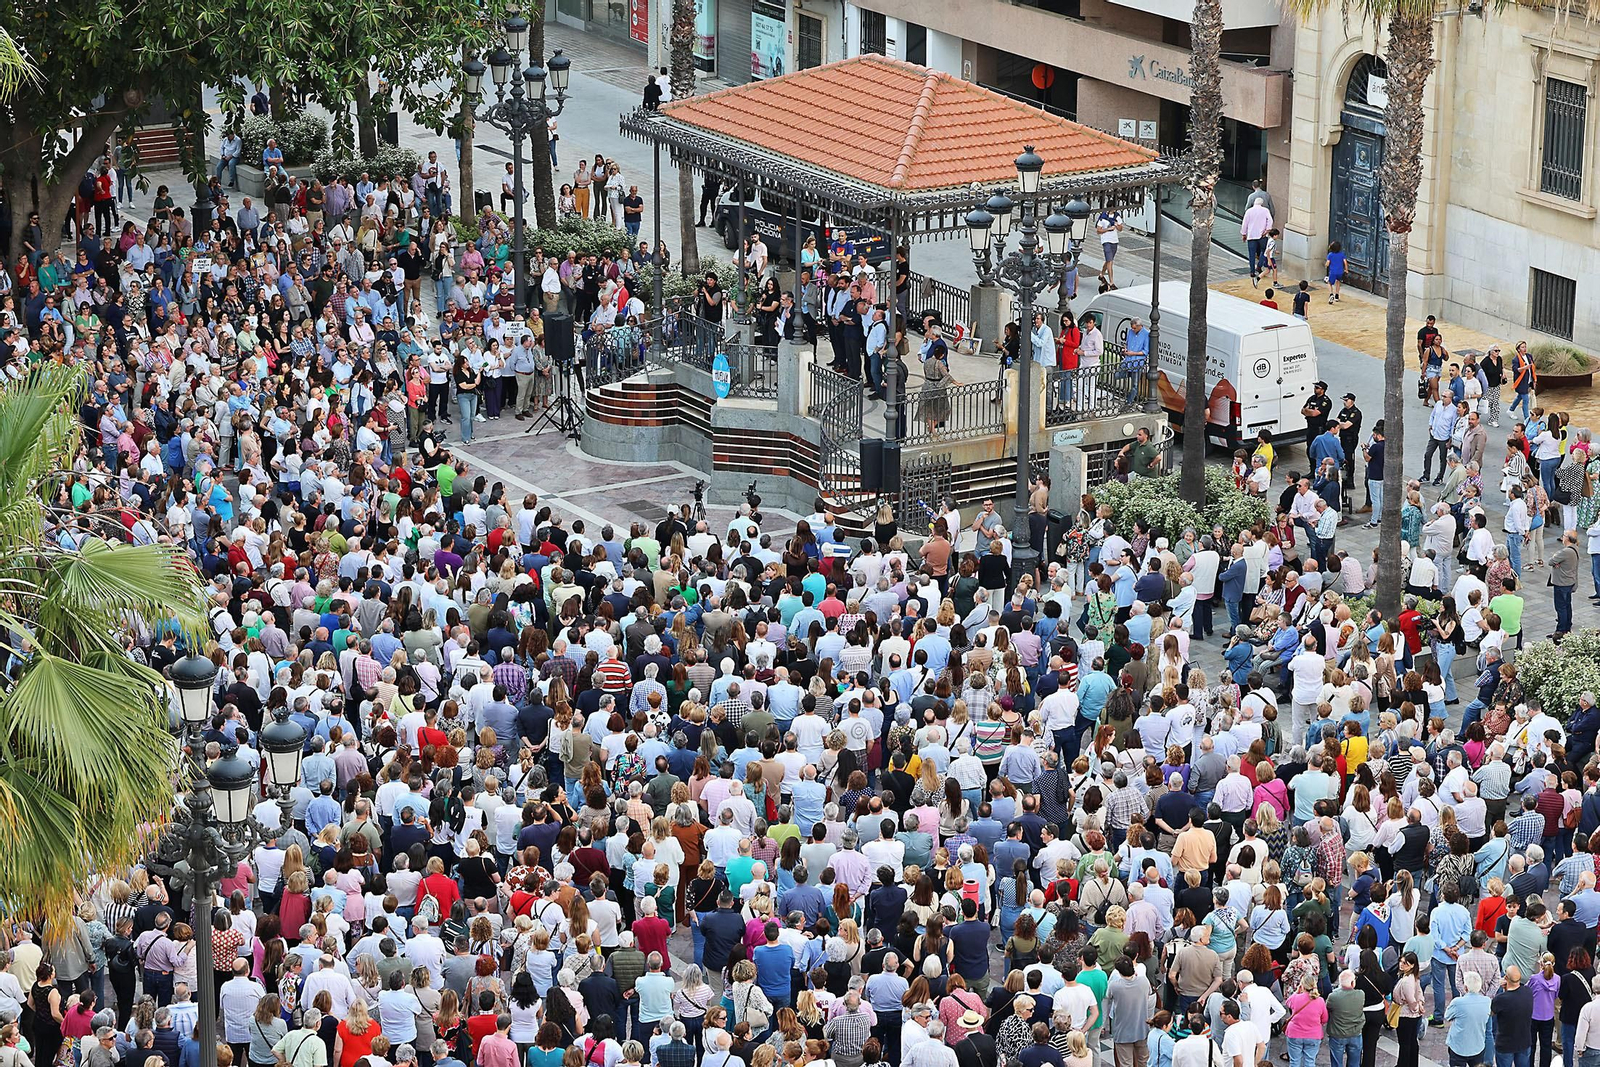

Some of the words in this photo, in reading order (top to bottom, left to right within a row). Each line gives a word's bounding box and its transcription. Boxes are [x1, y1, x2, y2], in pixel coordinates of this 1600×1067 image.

[1371, 82, 1385, 94] ánf
[754, 218, 780, 232] POLICIA
[754, 226, 782, 239] NACIONA
[848, 237, 874, 246] OLICIA
[1158, 341, 1171, 350] NIDO
[1158, 347, 1186, 361] MINACIÓN
[1283, 352, 1307, 363] Expertos
[1158, 355, 1183, 367] LTIMEDIA
[1256, 363, 1267, 371] dB
